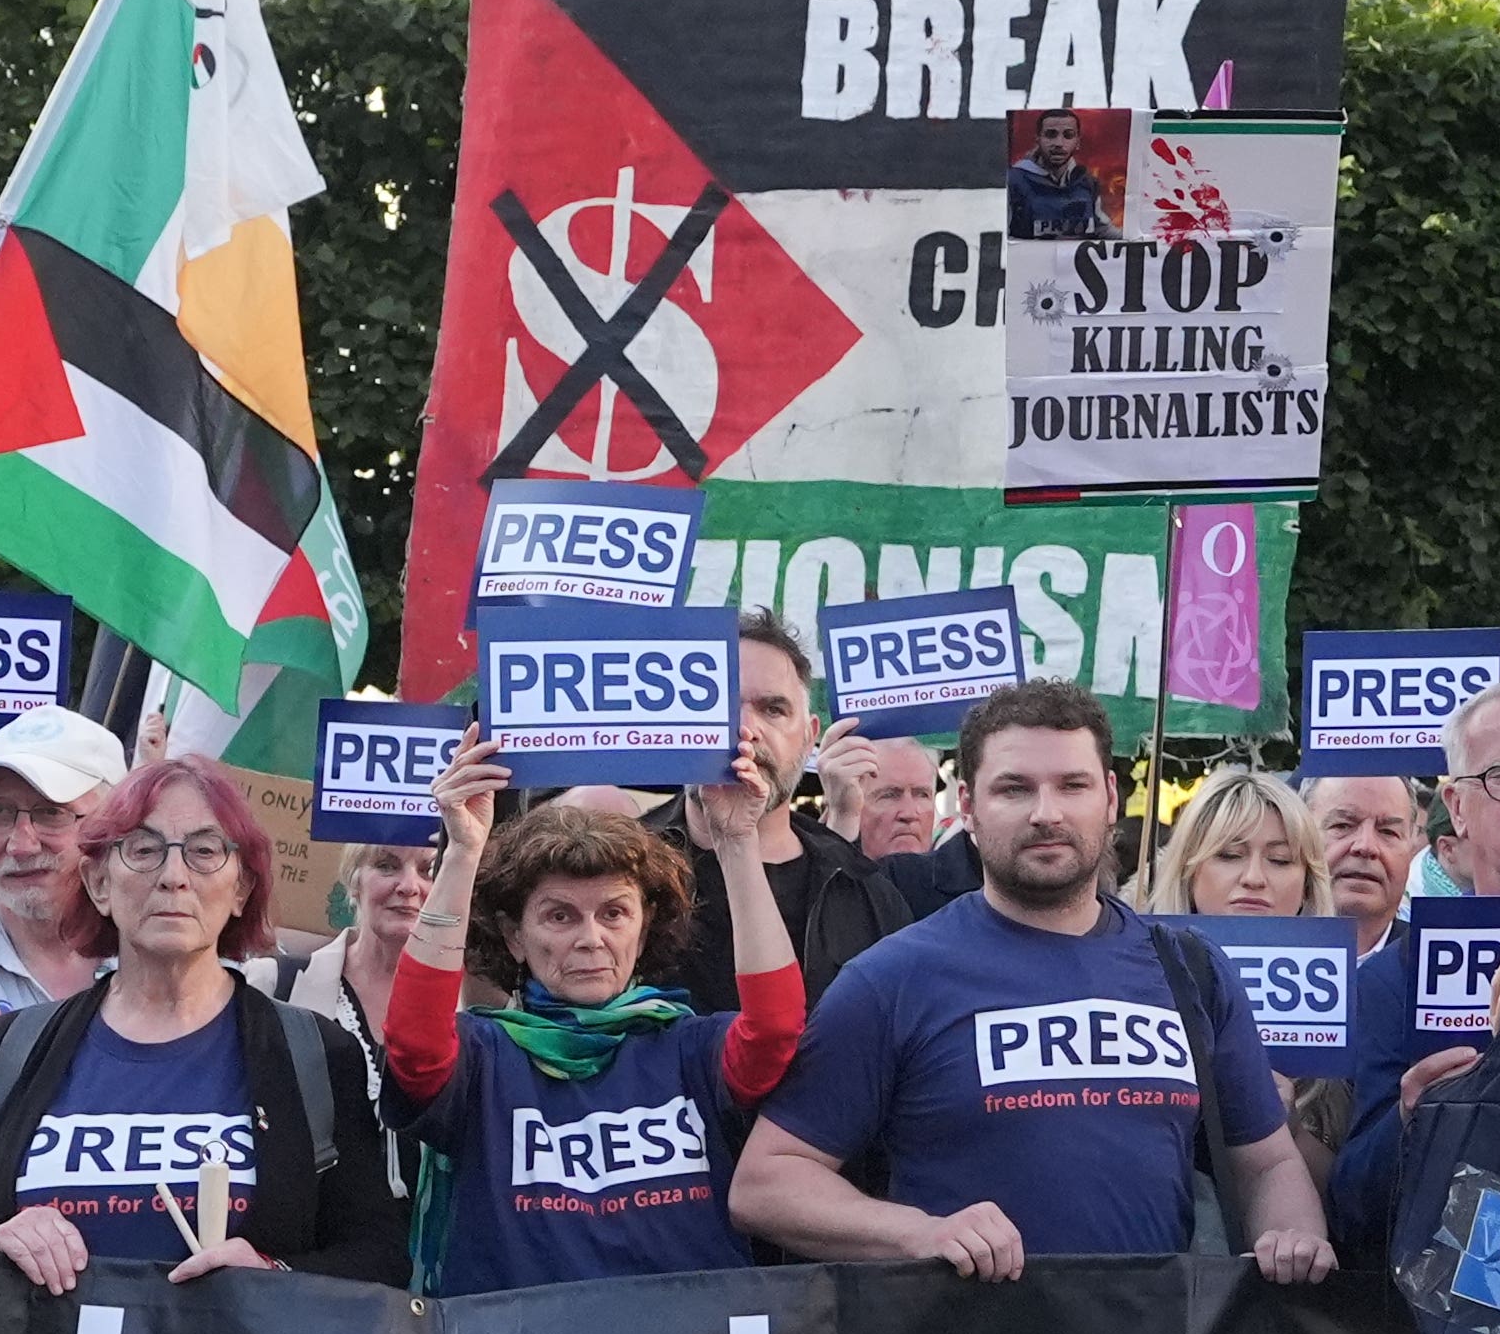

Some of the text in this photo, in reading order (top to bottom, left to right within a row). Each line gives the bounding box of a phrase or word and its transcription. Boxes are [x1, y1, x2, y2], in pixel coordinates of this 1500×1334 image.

[1074, 240, 1268, 315] STOP
[1070, 326, 1266, 373] KILLING
[1008, 388, 1320, 449] JOURNALISTS
[490, 513, 677, 574] PRESS
[485, 579, 665, 604] Freedom for Gaza now
[838, 620, 1006, 683] PRESS
[499, 651, 719, 714] PRESS
[845, 691, 910, 709] Freedom
[915, 690, 934, 702] for
[940, 685, 976, 698] Gaza
[501, 730, 720, 748] Freedom for Gaza now
[1318, 733, 1384, 745] Freedom
[1390, 732, 1410, 744] for
[262, 790, 313, 819] ONLY
[329, 796, 395, 810] Freedom
[401, 799, 422, 812] for
[1424, 1013, 1489, 1027] Freedo
[989, 1011, 1188, 1071] PRESS
[1259, 1028, 1338, 1042] Gaza now
[985, 1090, 1078, 1113] freedom
[1082, 1089, 1111, 1106] for
[1117, 1087, 1164, 1105] Gaza
[526, 1107, 707, 1179] PRESS
[109, 1195, 143, 1214] for
[515, 1194, 594, 1216] freedom
[601, 1191, 627, 1214] for
[634, 1188, 683, 1208] Gaza
